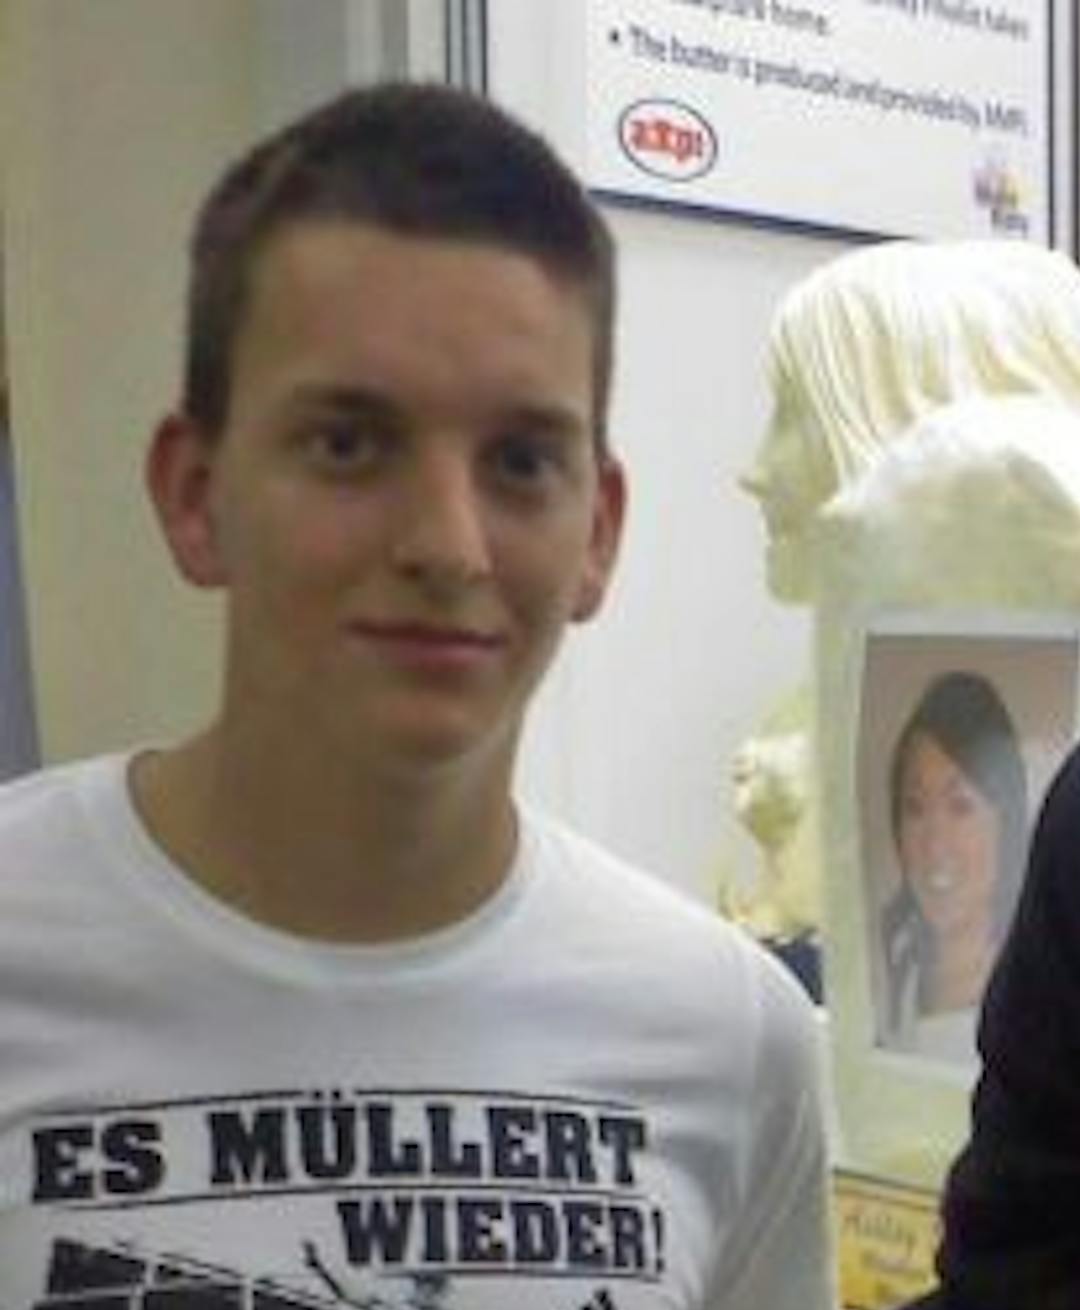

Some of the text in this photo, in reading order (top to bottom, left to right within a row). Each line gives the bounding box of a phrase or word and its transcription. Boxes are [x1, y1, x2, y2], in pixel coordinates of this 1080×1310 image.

[630, 24, 666, 62] The
[671, 36, 731, 73] butter
[755, 60, 839, 98] produced
[30, 1090, 648, 1204] ES MÜLLERT
[337, 1198, 667, 1273] WIEDER!
